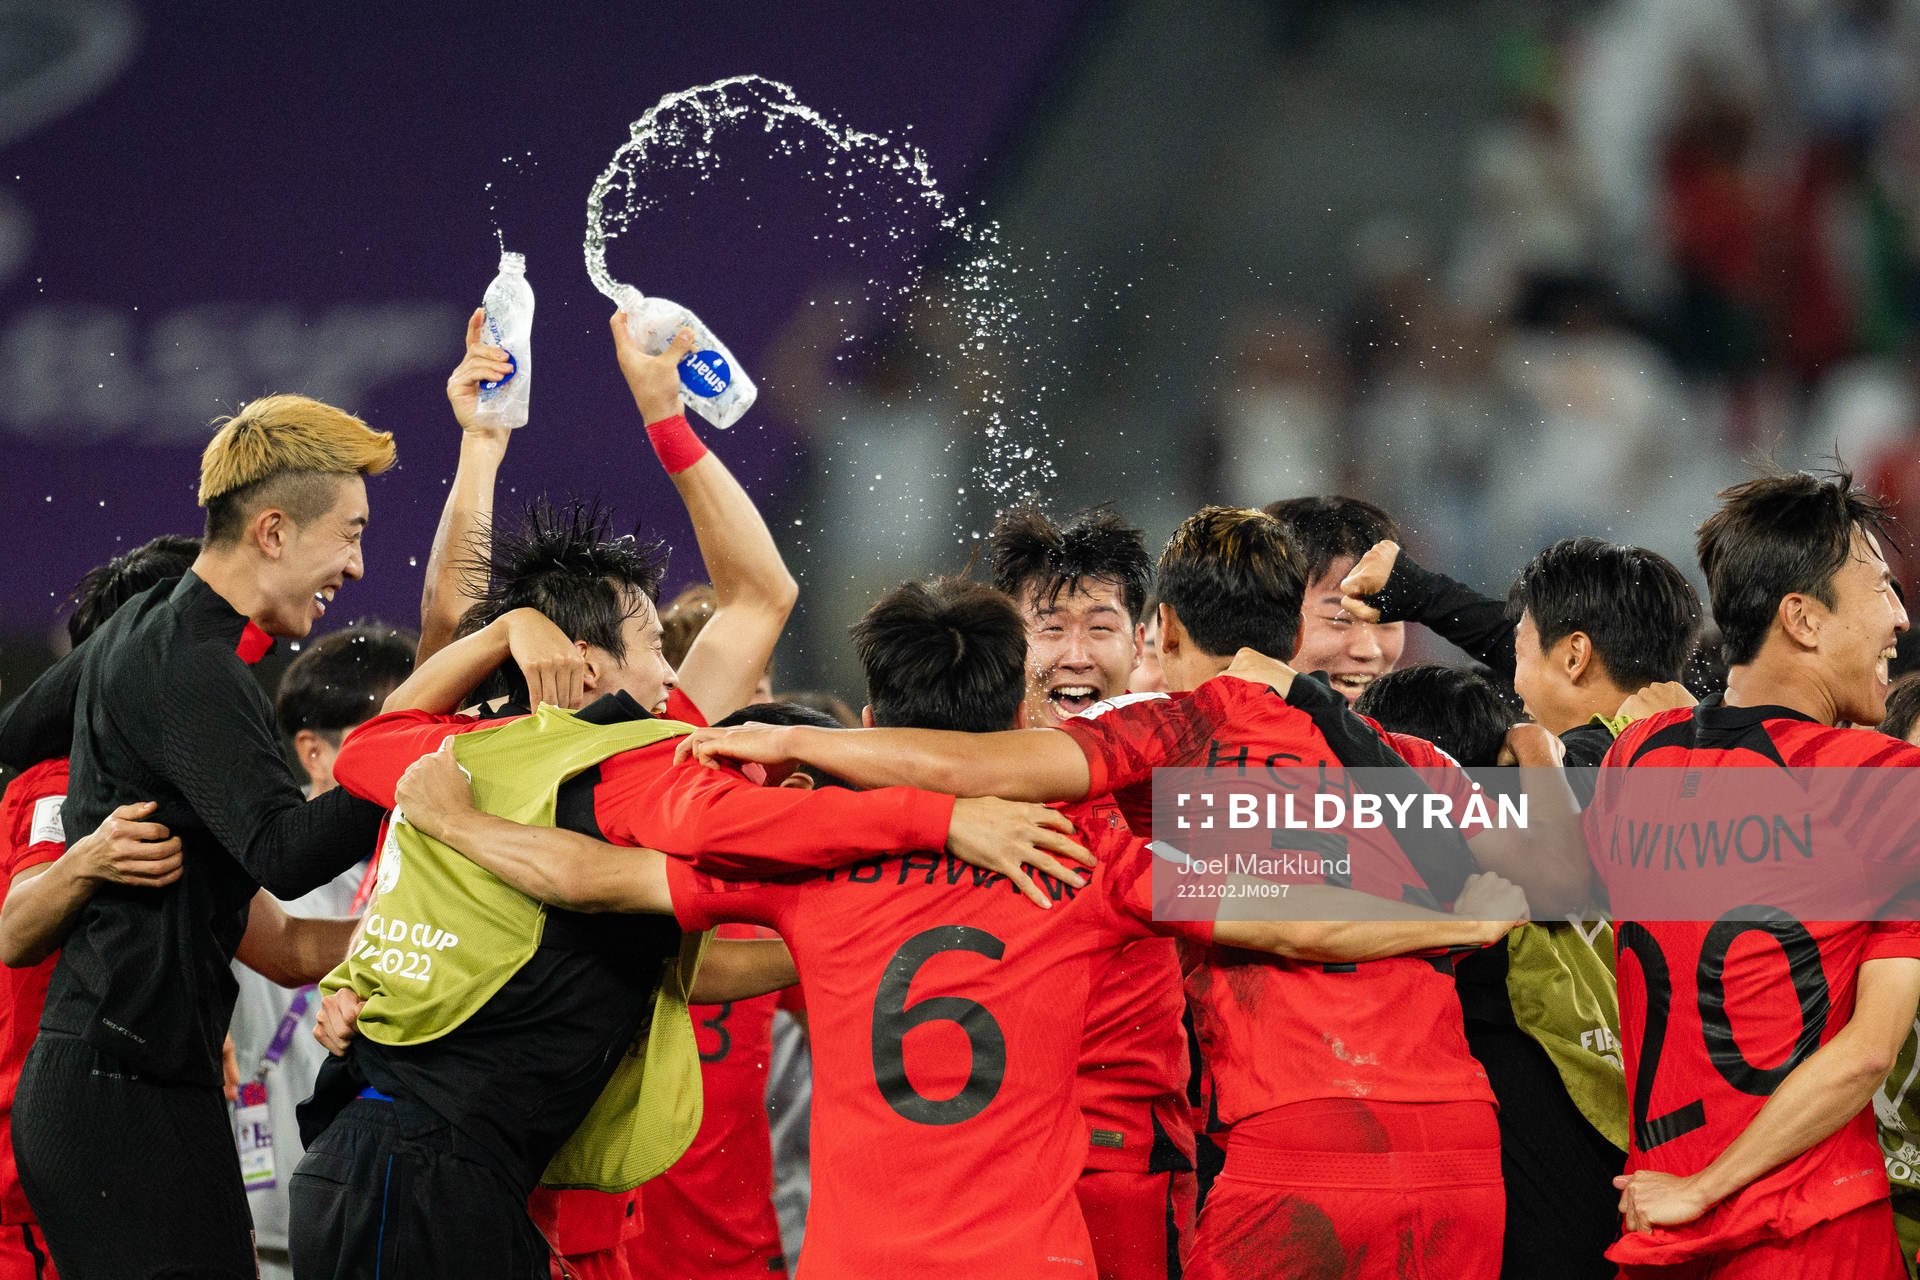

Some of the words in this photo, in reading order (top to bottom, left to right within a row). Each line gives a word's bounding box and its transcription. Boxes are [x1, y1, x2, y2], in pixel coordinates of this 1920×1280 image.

[686, 353, 727, 393] smart
[411, 923, 459, 951] CUP
[872, 925, 1006, 1125] 6
[1617, 904, 1832, 1154] 20
